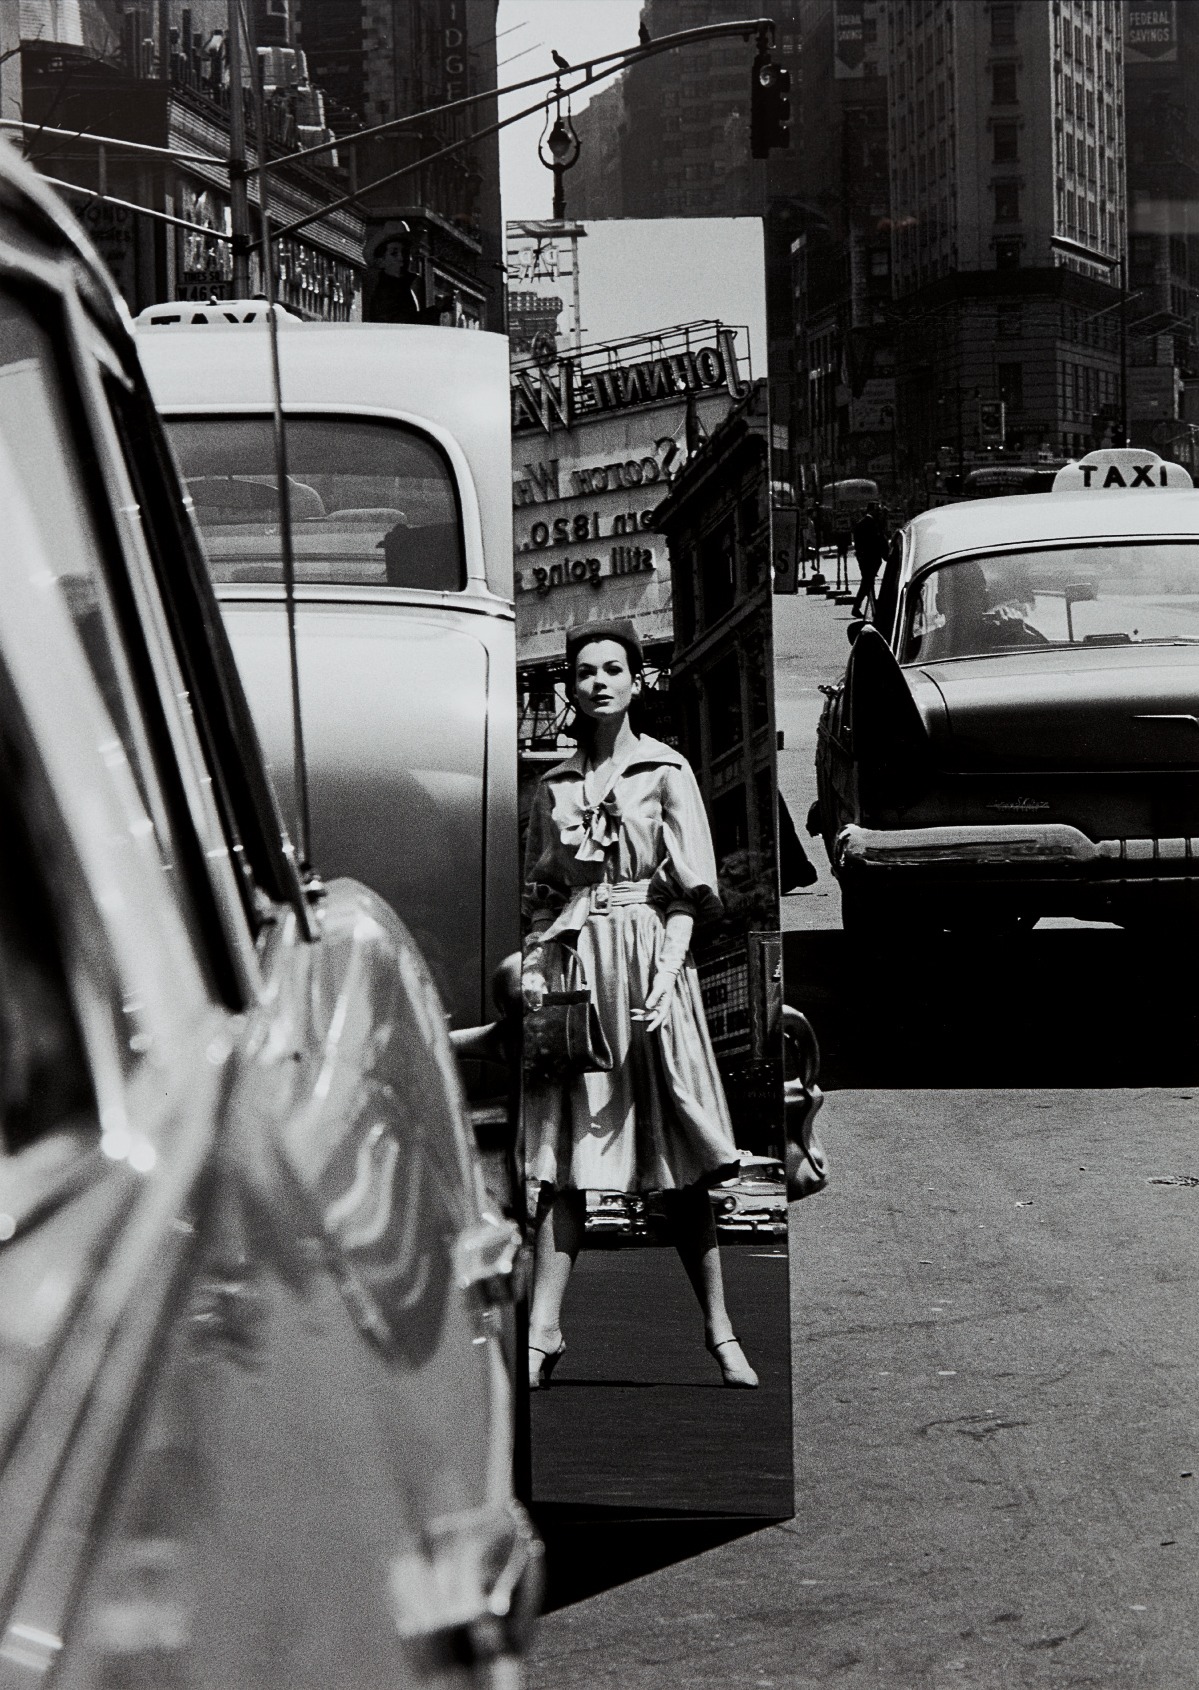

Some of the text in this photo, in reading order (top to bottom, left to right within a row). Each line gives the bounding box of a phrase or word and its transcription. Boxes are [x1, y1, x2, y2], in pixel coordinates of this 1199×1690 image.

[1129, 11, 1170, 26] FEDERAL
[1129, 27, 1170, 42] SAVINGS
[183, 272, 207, 281] TIMES
[191, 286, 207, 300] 46
[210, 285, 225, 300] ST
[1078, 464, 1168, 488] TAXI
